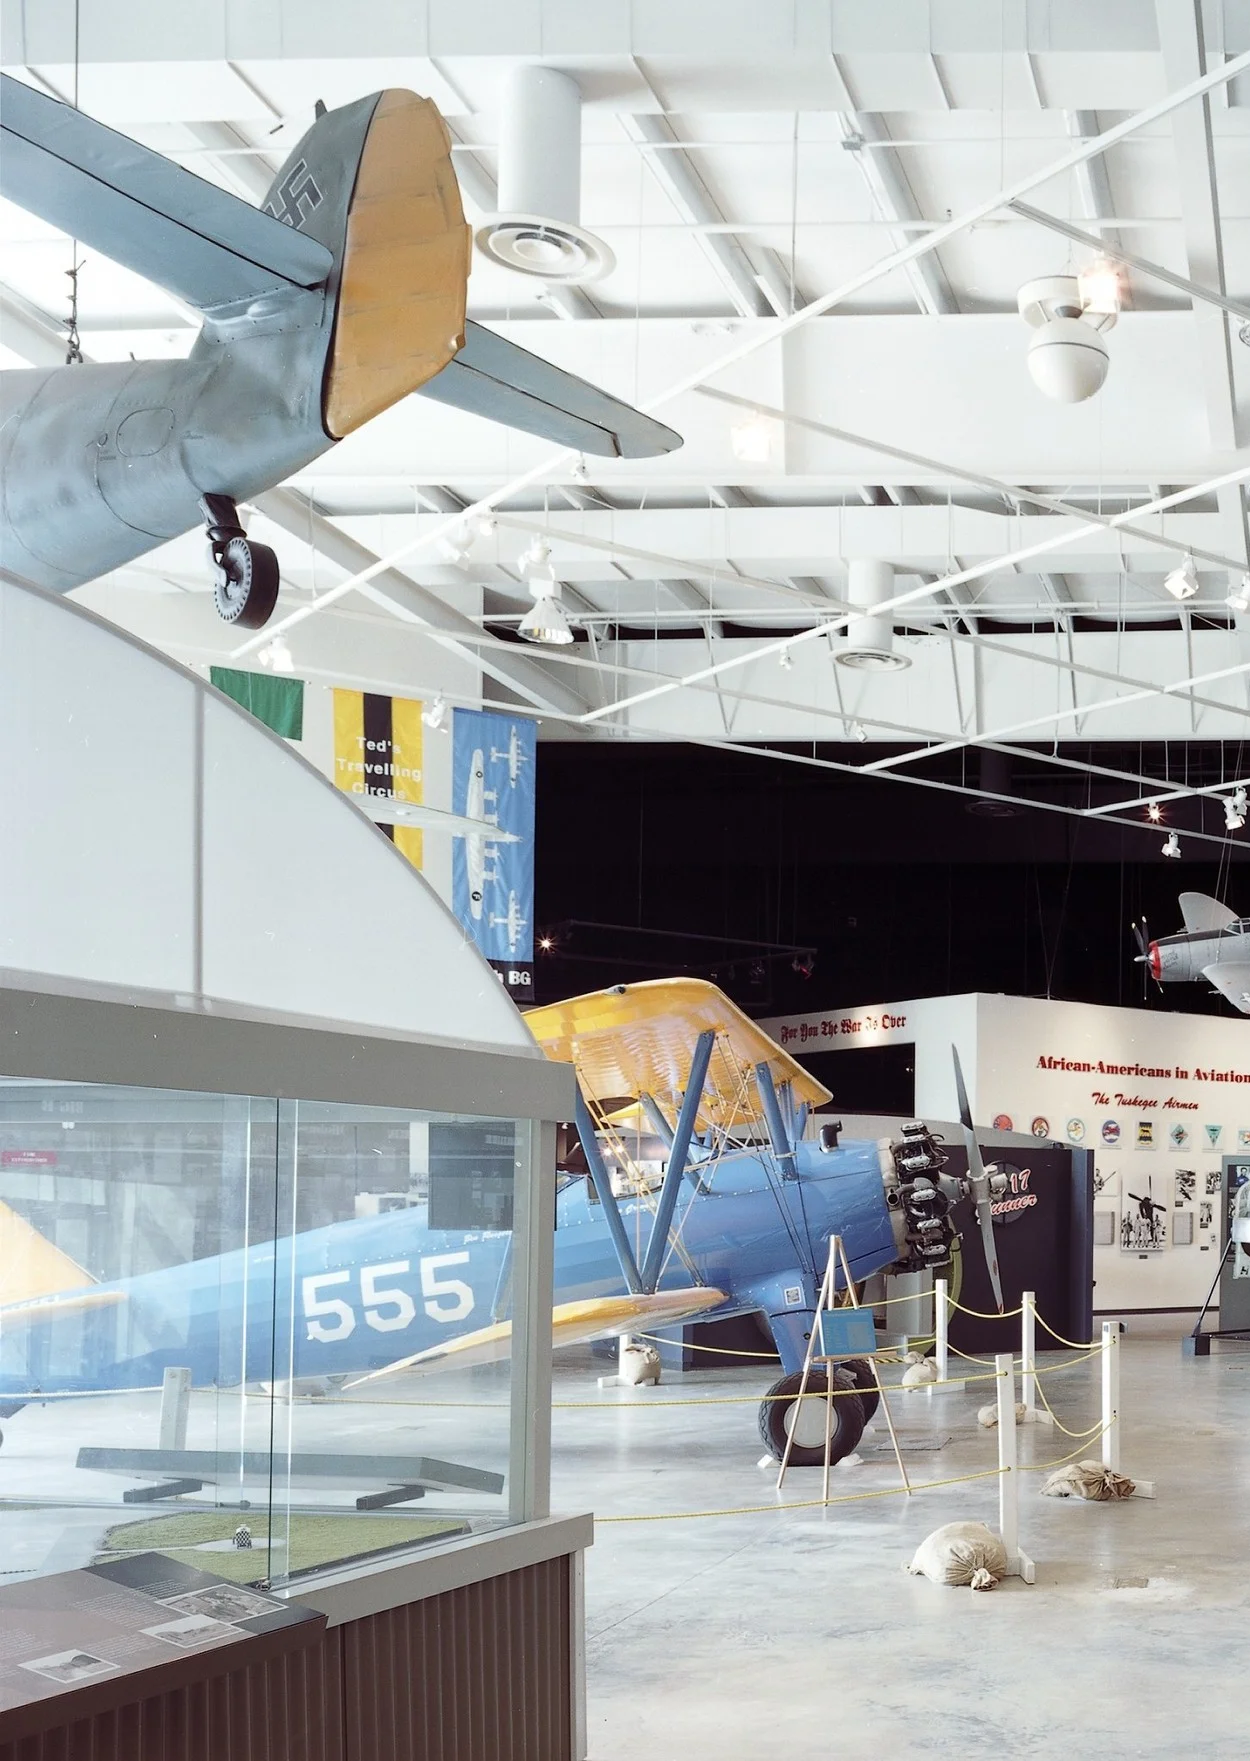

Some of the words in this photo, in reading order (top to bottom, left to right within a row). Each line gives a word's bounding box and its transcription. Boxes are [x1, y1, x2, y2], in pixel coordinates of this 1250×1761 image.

[356, 736, 401, 754] Ted's
[336, 758, 422, 782] Travelling
[352, 782, 406, 799] Circus
[509, 970, 532, 986] BG
[781, 1025, 798, 1044] For
[800, 1023, 819, 1042] You
[821, 1020, 839, 1039] The
[841, 1018, 862, 1035] War
[881, 1014, 907, 1030] Over
[1036, 1056, 1172, 1079] African-Americans
[1175, 1066, 1189, 1080] in
[1092, 1092, 1110, 1106] The
[1115, 1093, 1158, 1111] Tuskegee
[1162, 1096, 1200, 1111] Airmen
[1009, 1168, 1032, 1194] 17
[302, 1251, 476, 1343] 555
